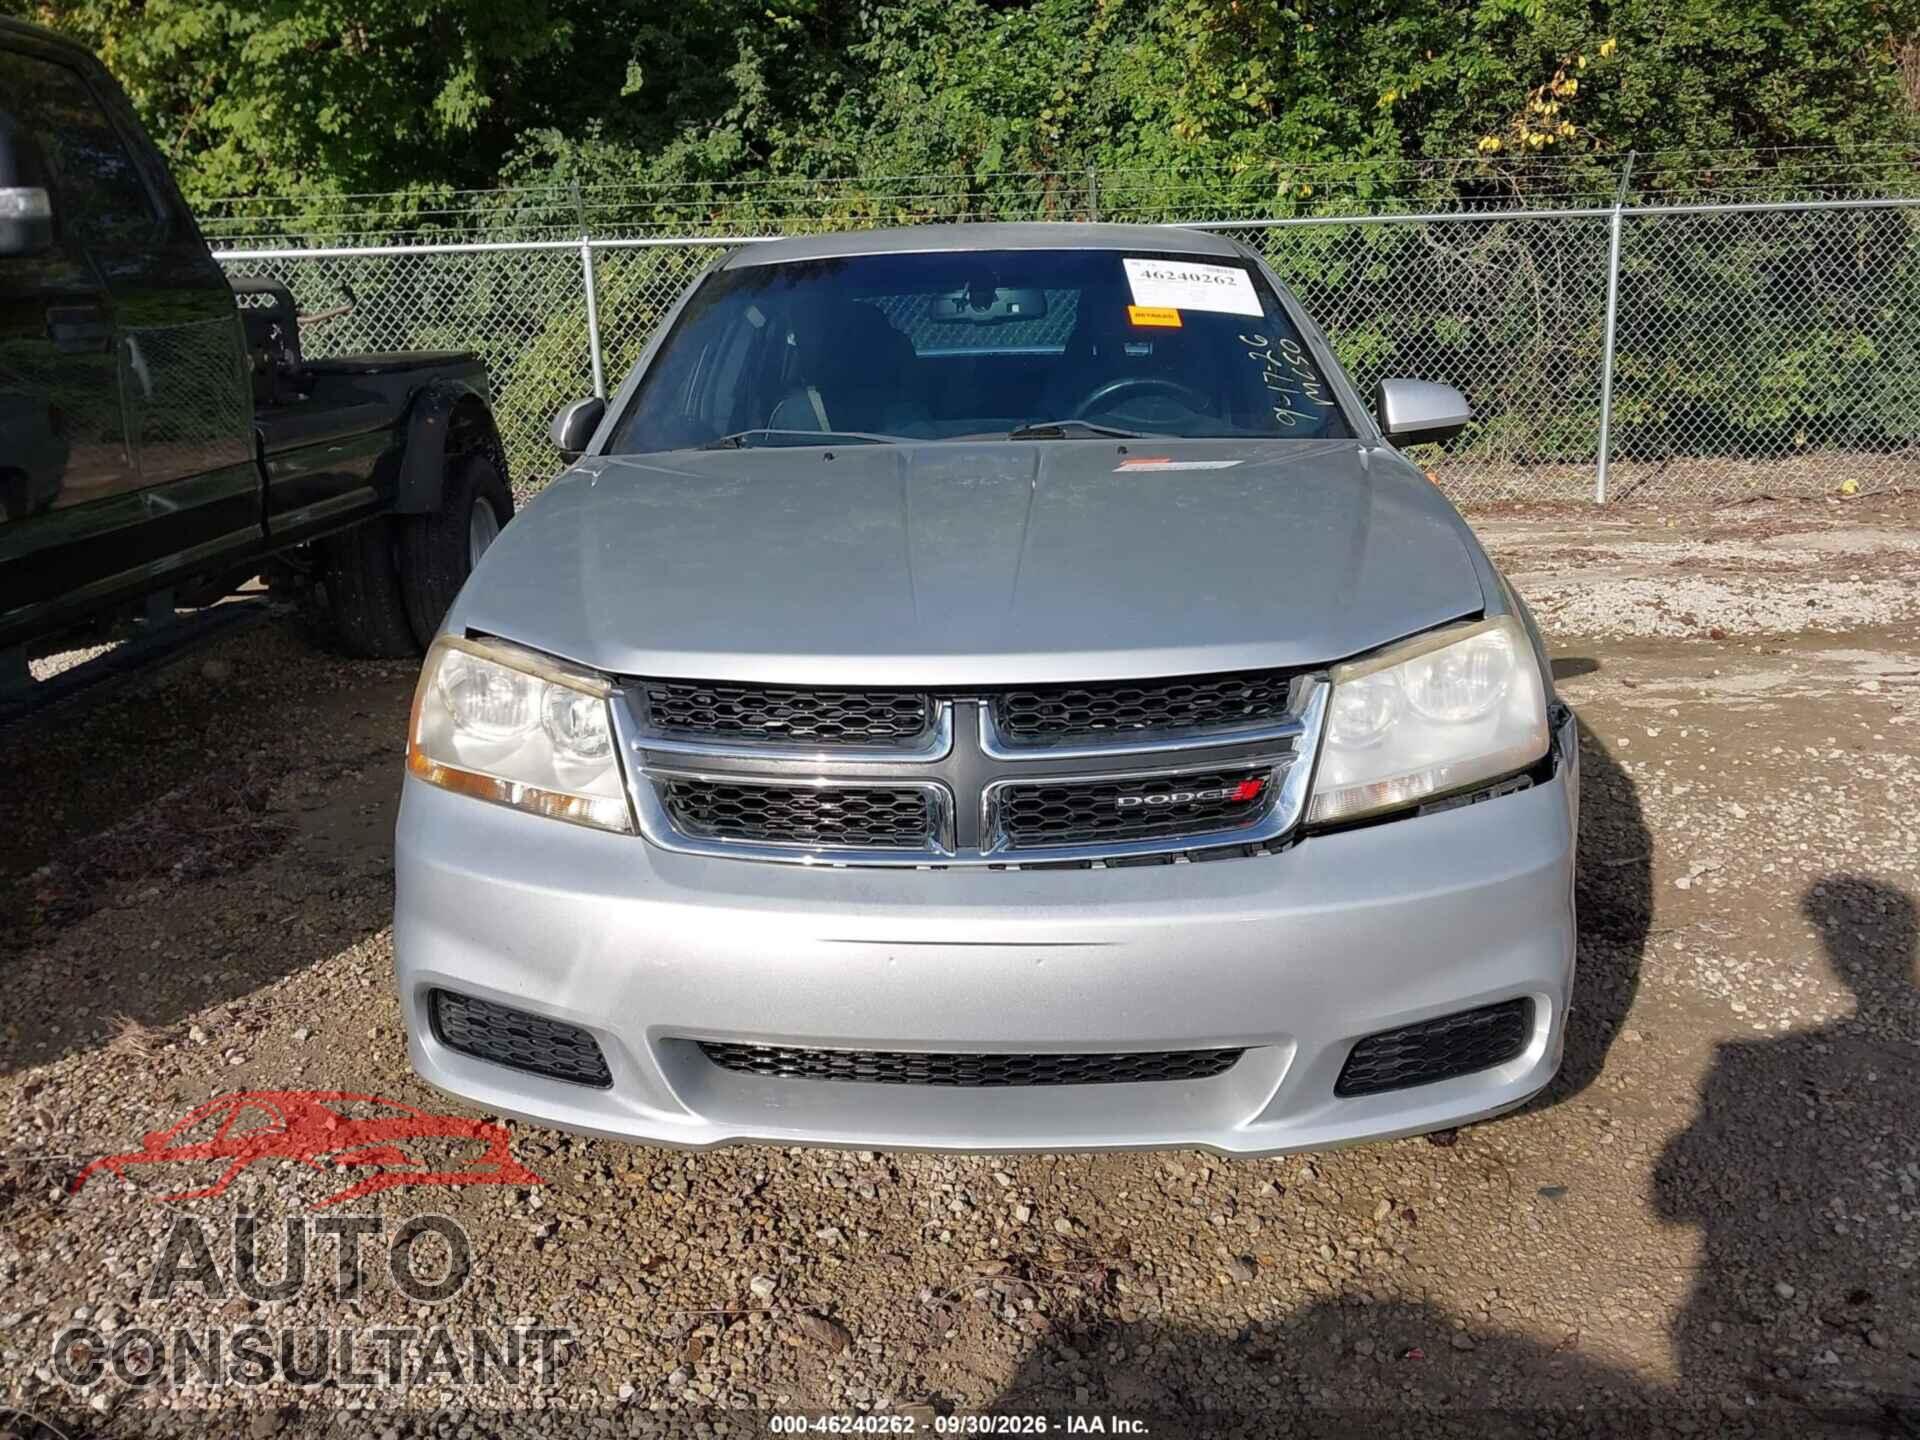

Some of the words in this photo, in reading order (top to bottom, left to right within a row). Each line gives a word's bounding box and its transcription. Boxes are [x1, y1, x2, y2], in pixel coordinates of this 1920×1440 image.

[1140, 269, 1238, 286] 46240262
[1238, 334, 1319, 426] 9-17-26
[1117, 787, 1240, 807] DODGE
